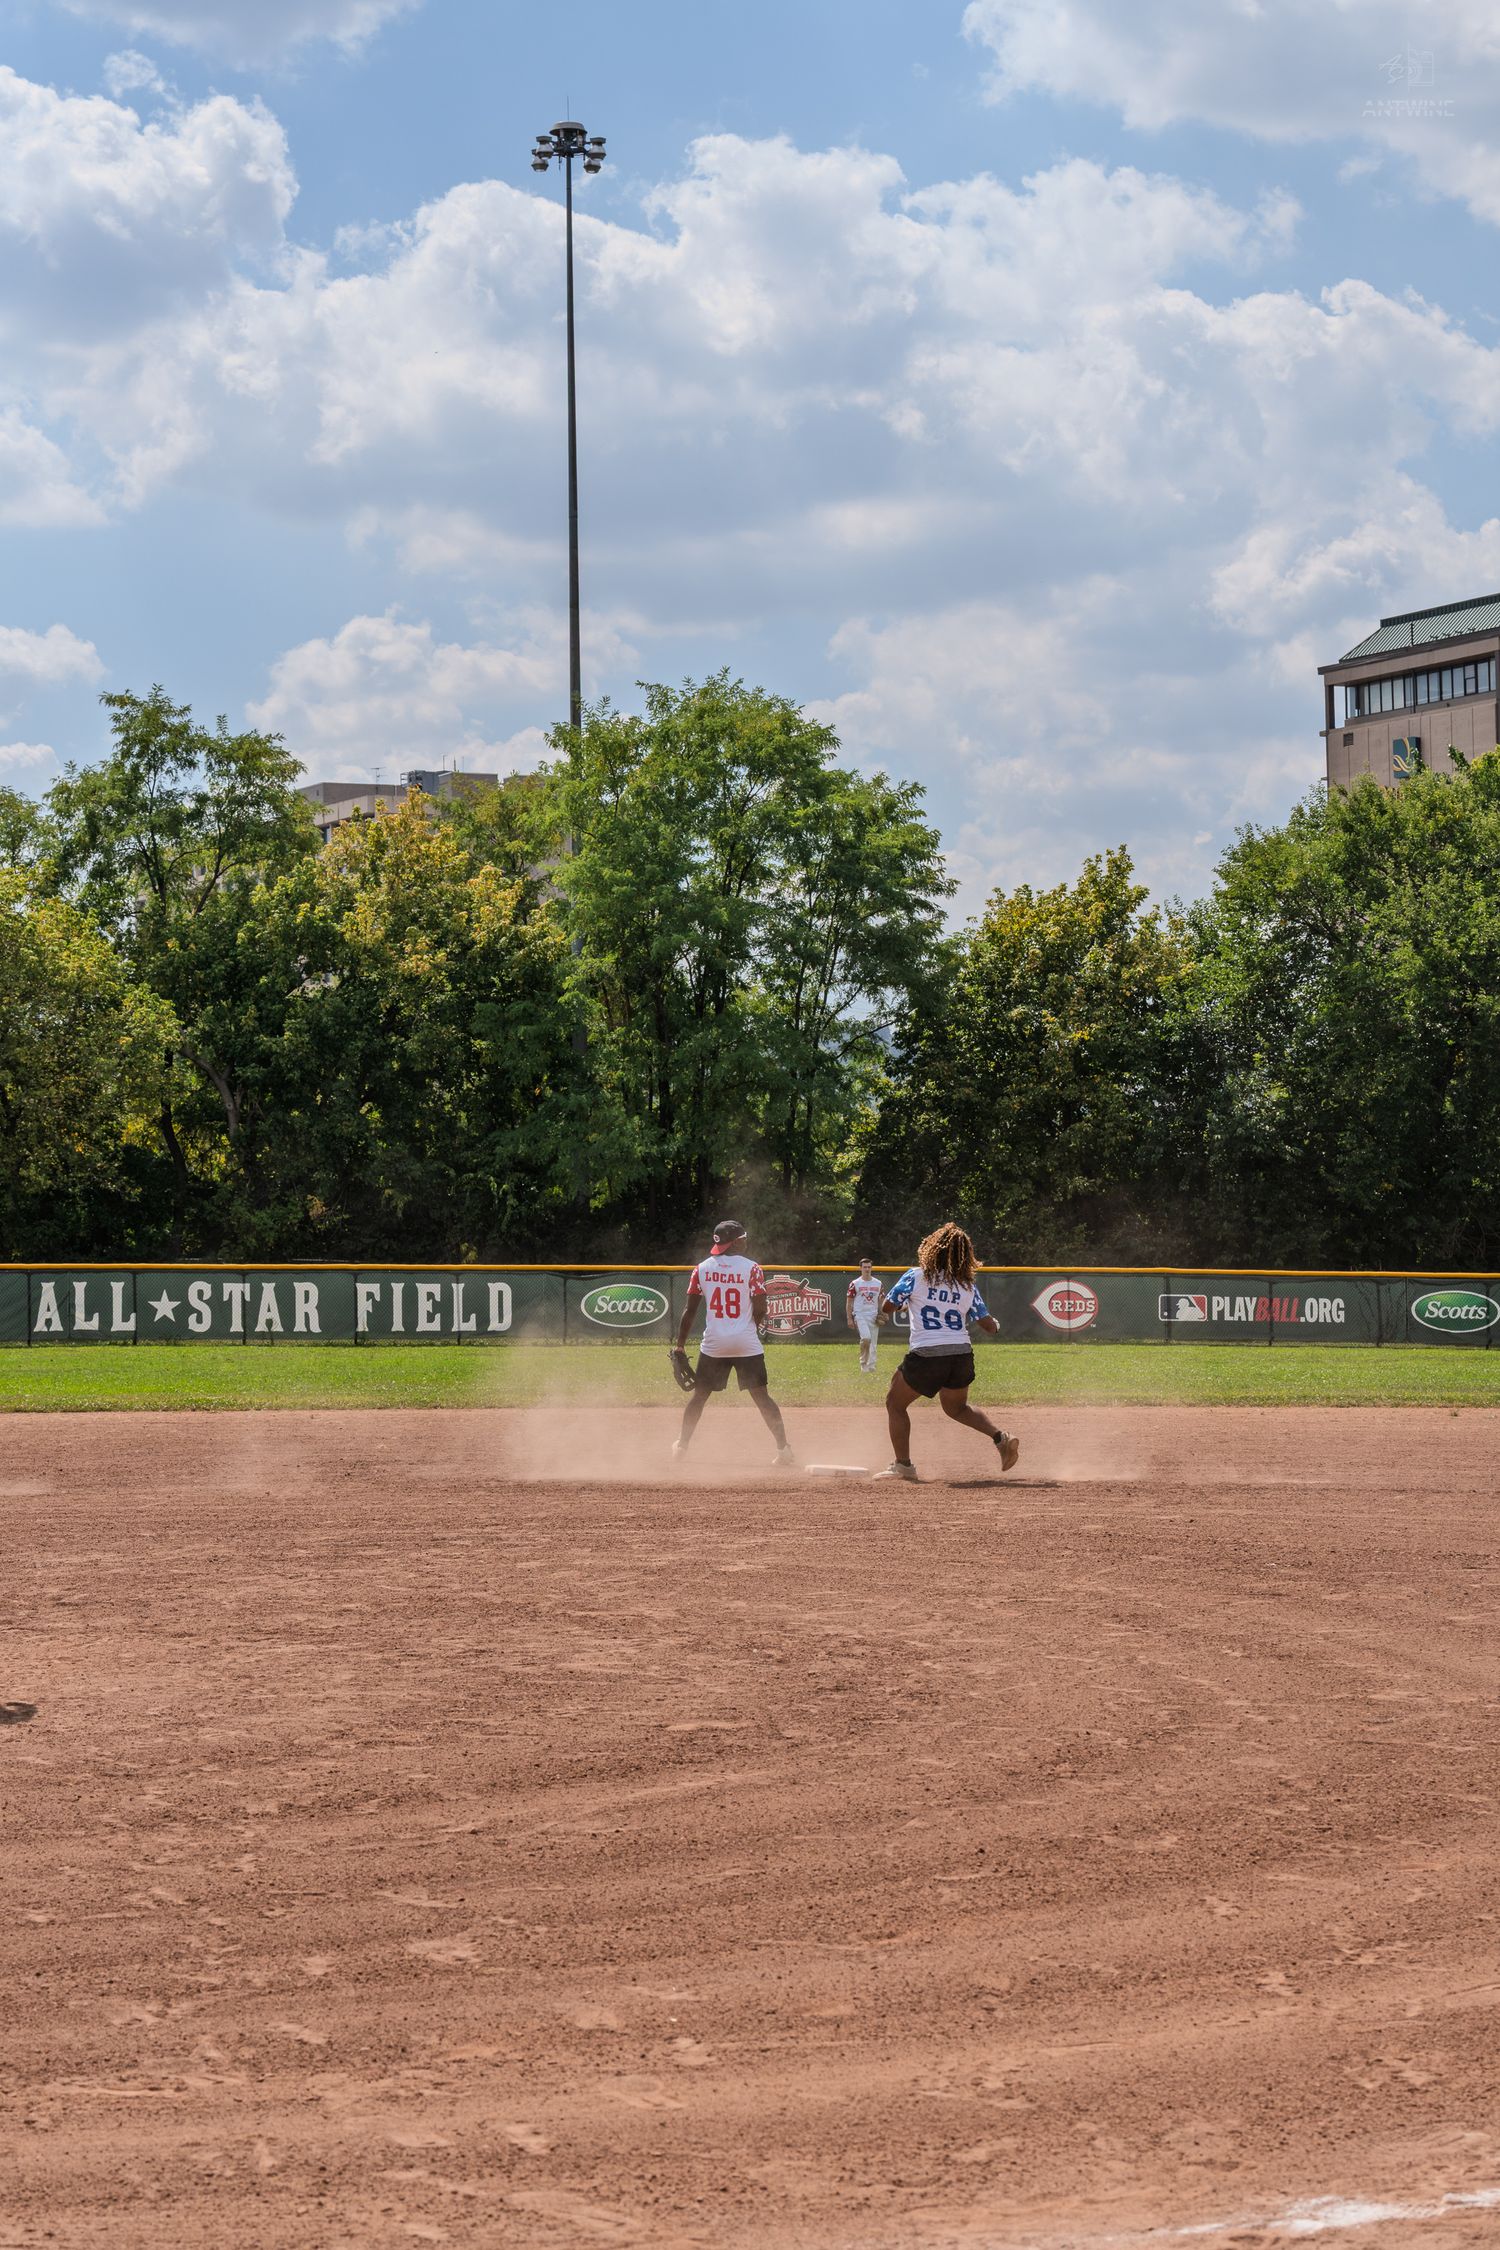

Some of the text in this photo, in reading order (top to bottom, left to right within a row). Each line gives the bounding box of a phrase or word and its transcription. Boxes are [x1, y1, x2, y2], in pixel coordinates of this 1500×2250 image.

[705, 1271, 744, 1284] LOCAL
[594, 1295, 656, 1313] Scotts
[709, 1286, 741, 1319] 48
[794, 1296, 826, 1312] GAME
[927, 1287, 961, 1305] F.O.P.
[33, 1280, 513, 1333] ALL STAR FIELD
[1051, 1300, 1095, 1312] REDS
[1211, 1296, 1345, 1323] PLAYBALL.ORG
[1424, 1300, 1488, 1320] Scotts
